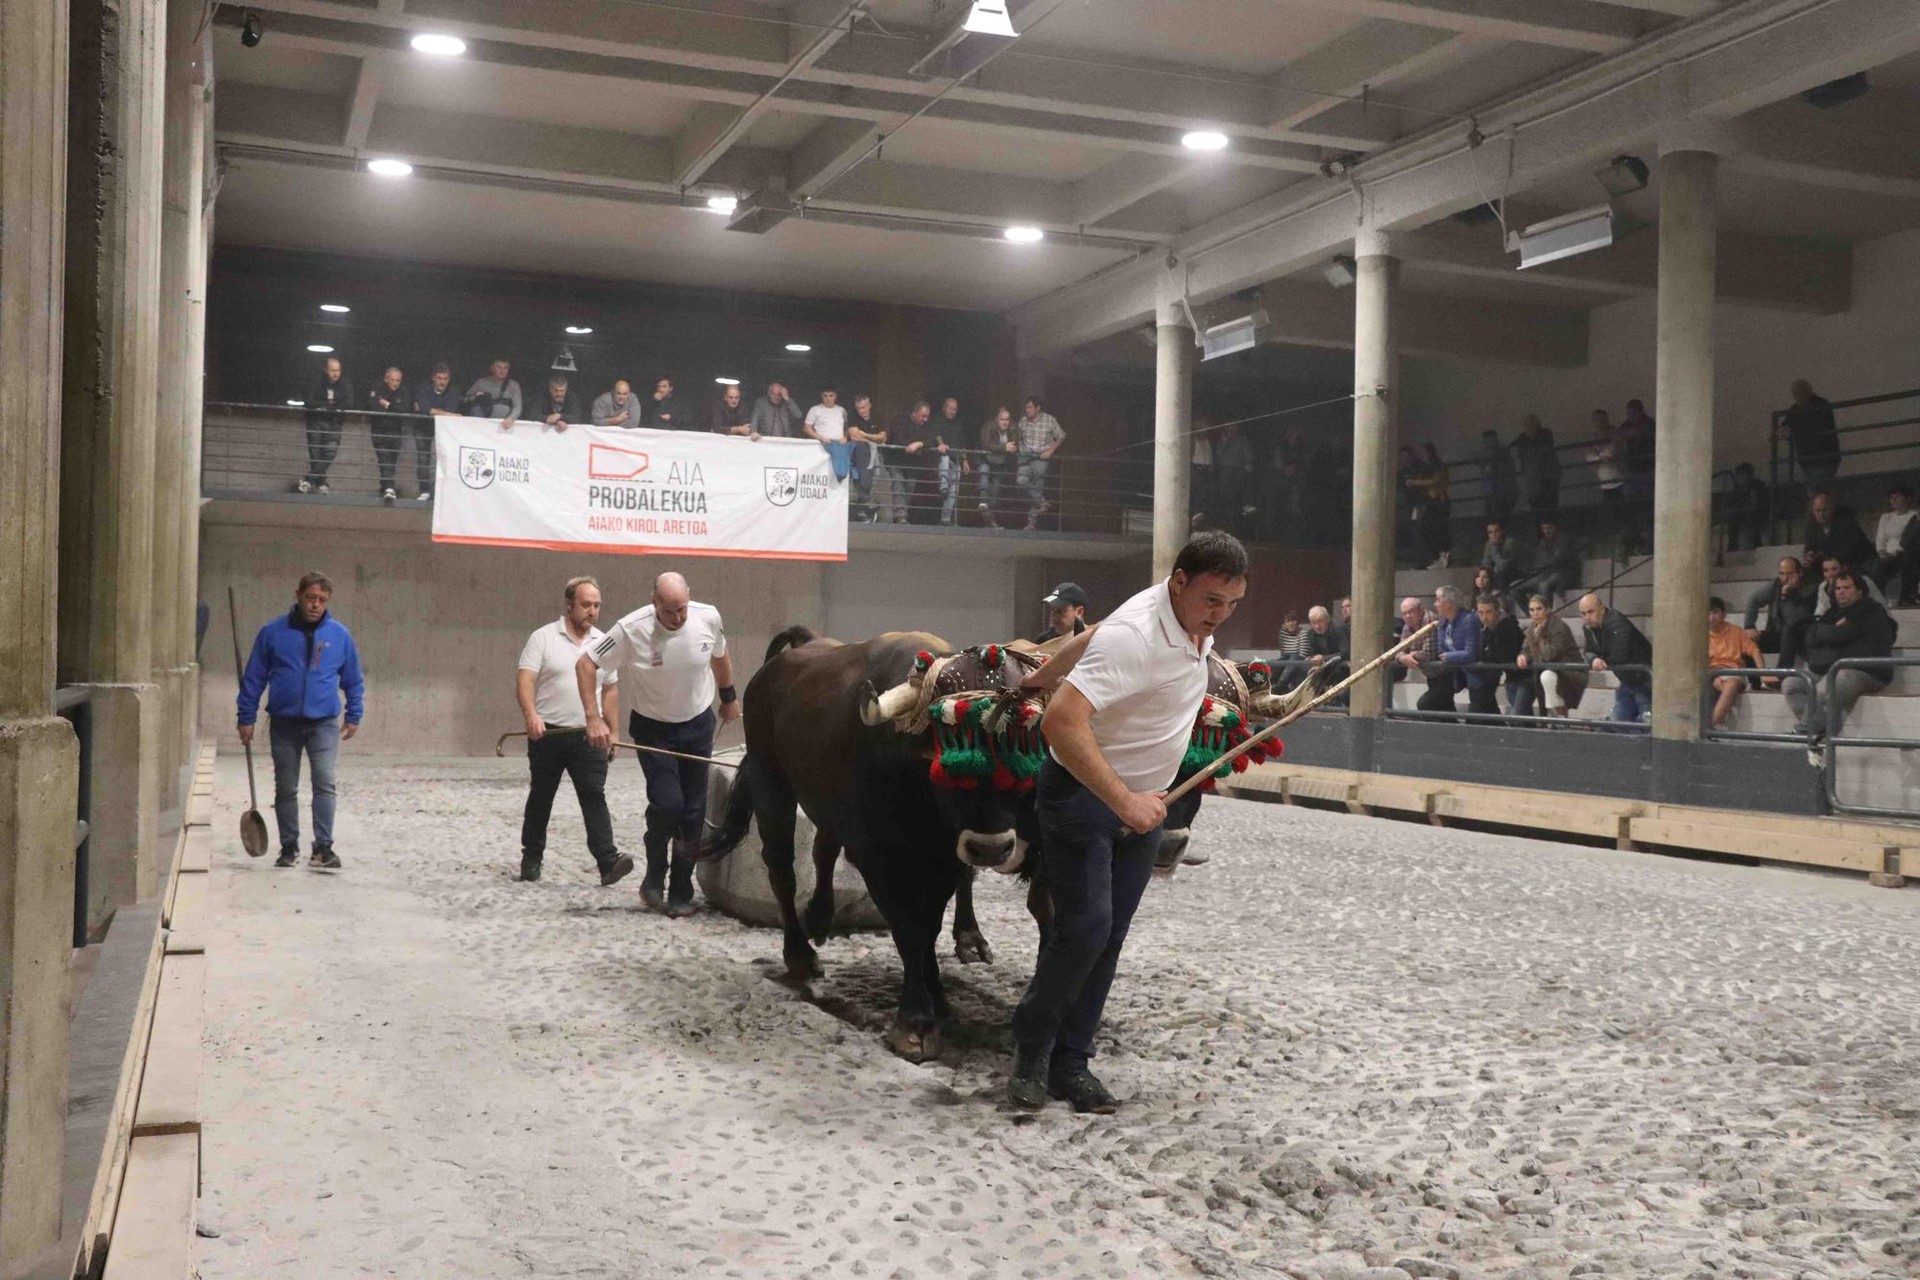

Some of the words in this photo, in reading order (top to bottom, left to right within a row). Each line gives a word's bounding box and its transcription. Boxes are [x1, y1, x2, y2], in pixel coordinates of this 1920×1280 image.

[498, 456, 530, 470] AIAKO
[498, 470, 530, 484] UDALA
[667, 461, 705, 486] AIA
[800, 473, 828, 487] AIAKO
[588, 485, 708, 514] PROBALEKUA
[800, 487, 828, 500] UDALA
[588, 515, 623, 532] AIAKO
[626, 518, 660, 534] KIROL
[663, 519, 708, 536] ARETOA
